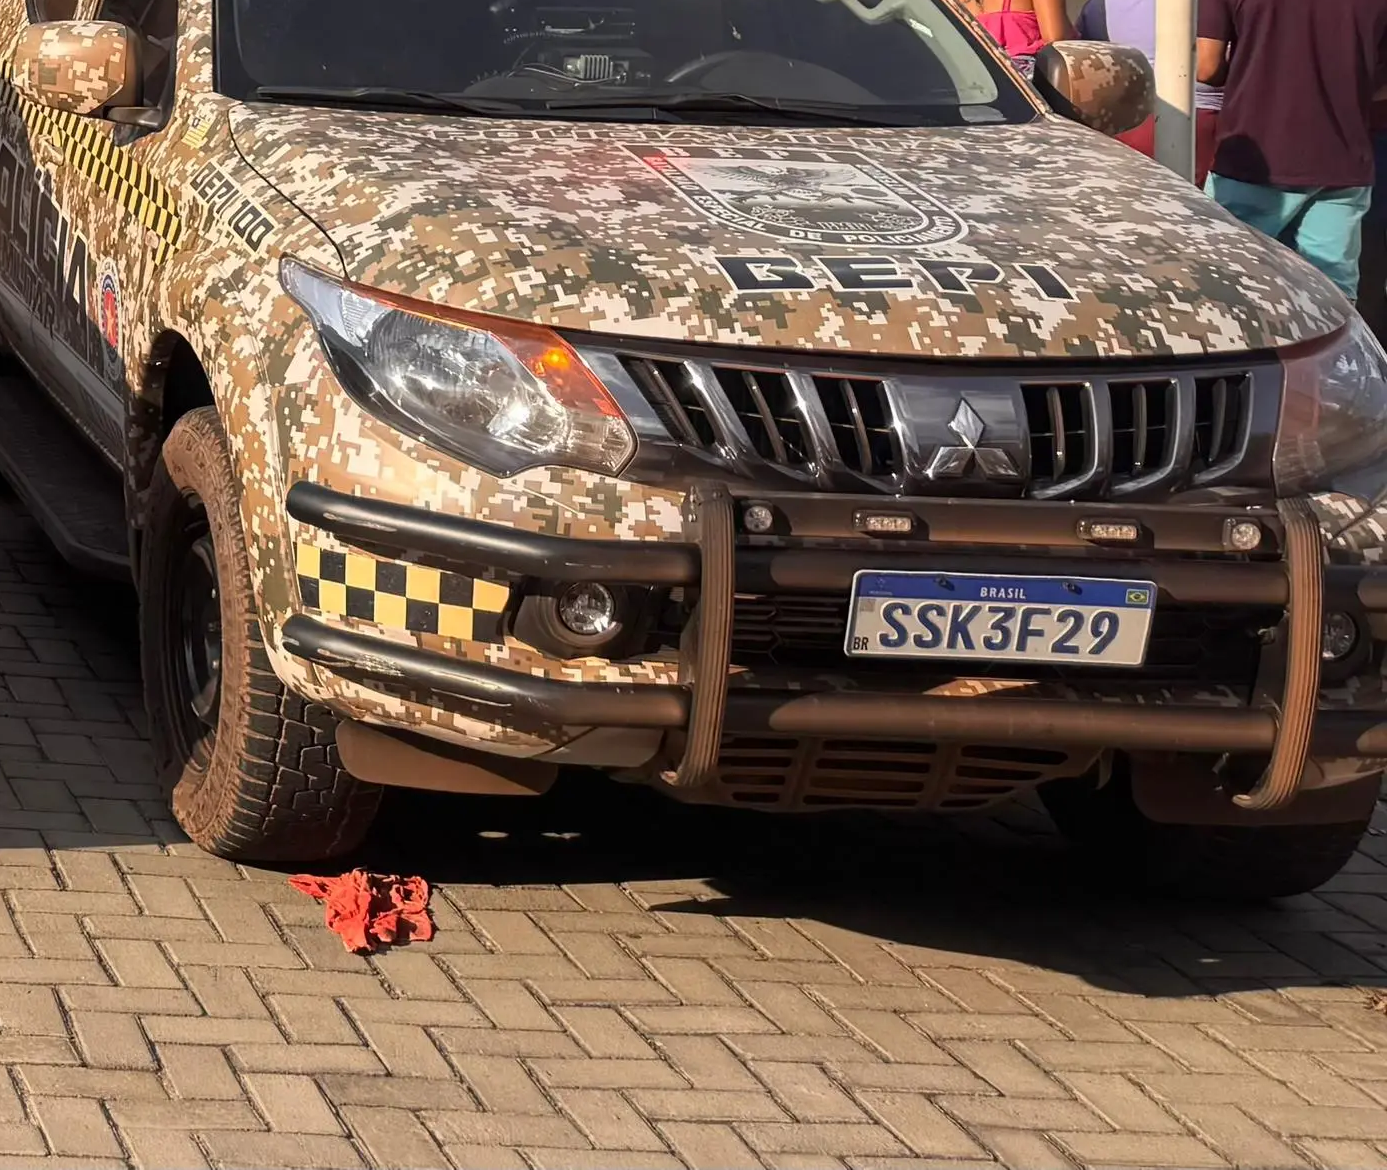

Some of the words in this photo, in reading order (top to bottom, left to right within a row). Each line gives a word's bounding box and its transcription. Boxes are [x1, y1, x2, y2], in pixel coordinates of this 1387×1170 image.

[653, 146, 838, 162] BEPI
[189, 161, 240, 215] BEPI
[227, 198, 276, 252] 100
[789, 229, 823, 242] DE
[712, 255, 1081, 303] BEPI
[980, 586, 1026, 599] BRASIL
[878, 601, 1121, 655] SSK3F29
[853, 636, 869, 651] BR
